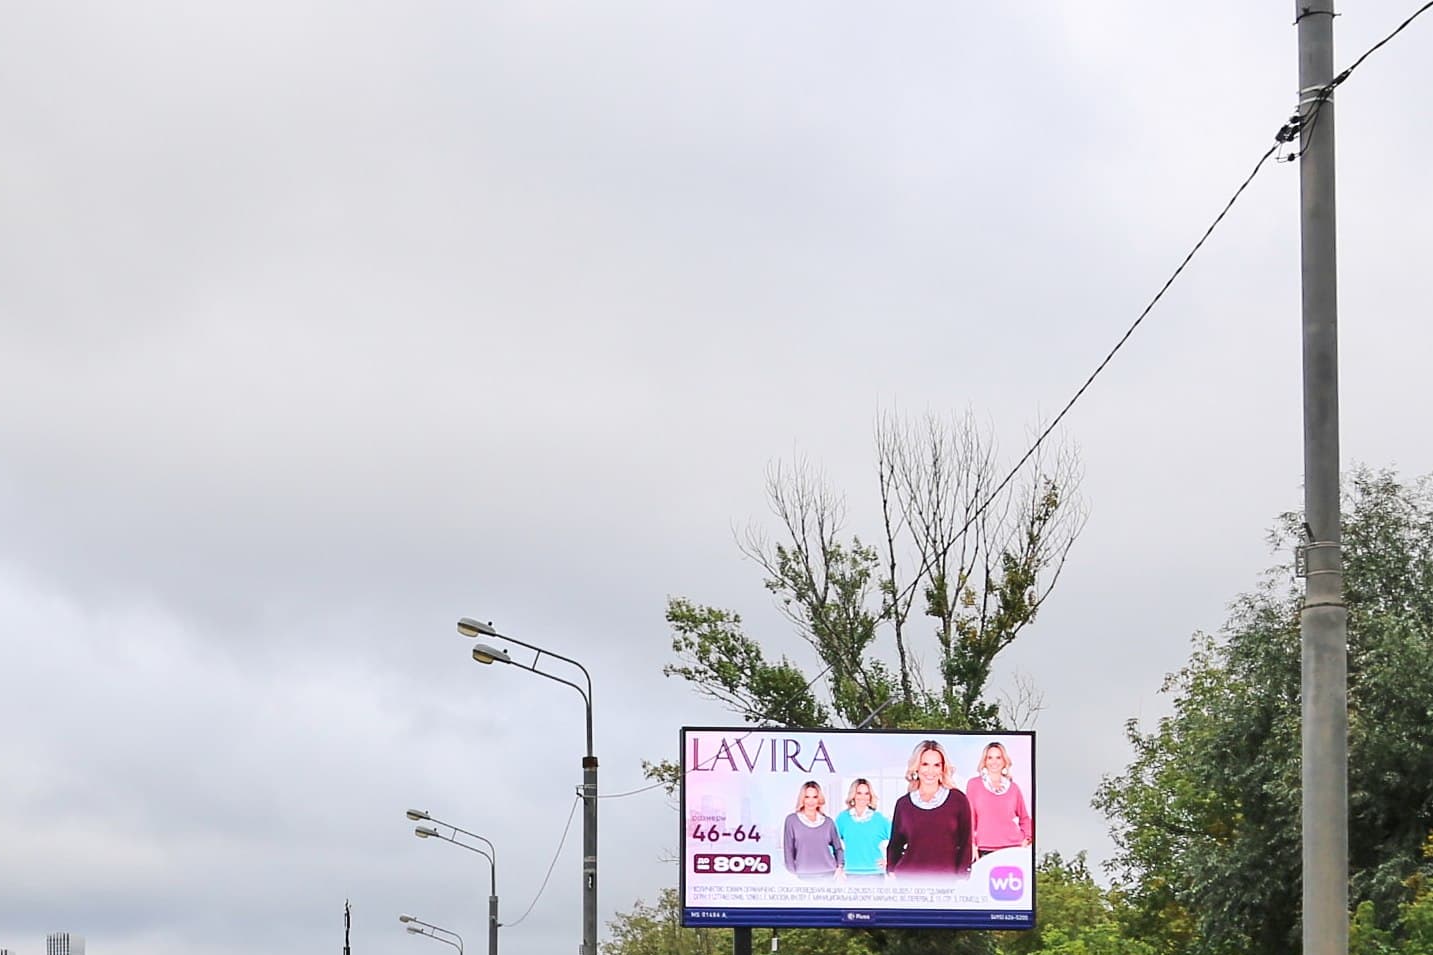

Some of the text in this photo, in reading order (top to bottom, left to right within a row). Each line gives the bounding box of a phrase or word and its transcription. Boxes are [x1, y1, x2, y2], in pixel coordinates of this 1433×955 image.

[692, 737, 836, 773] LAVIRA
[692, 824, 761, 842] 46-64
[991, 871, 1022, 891] wb
